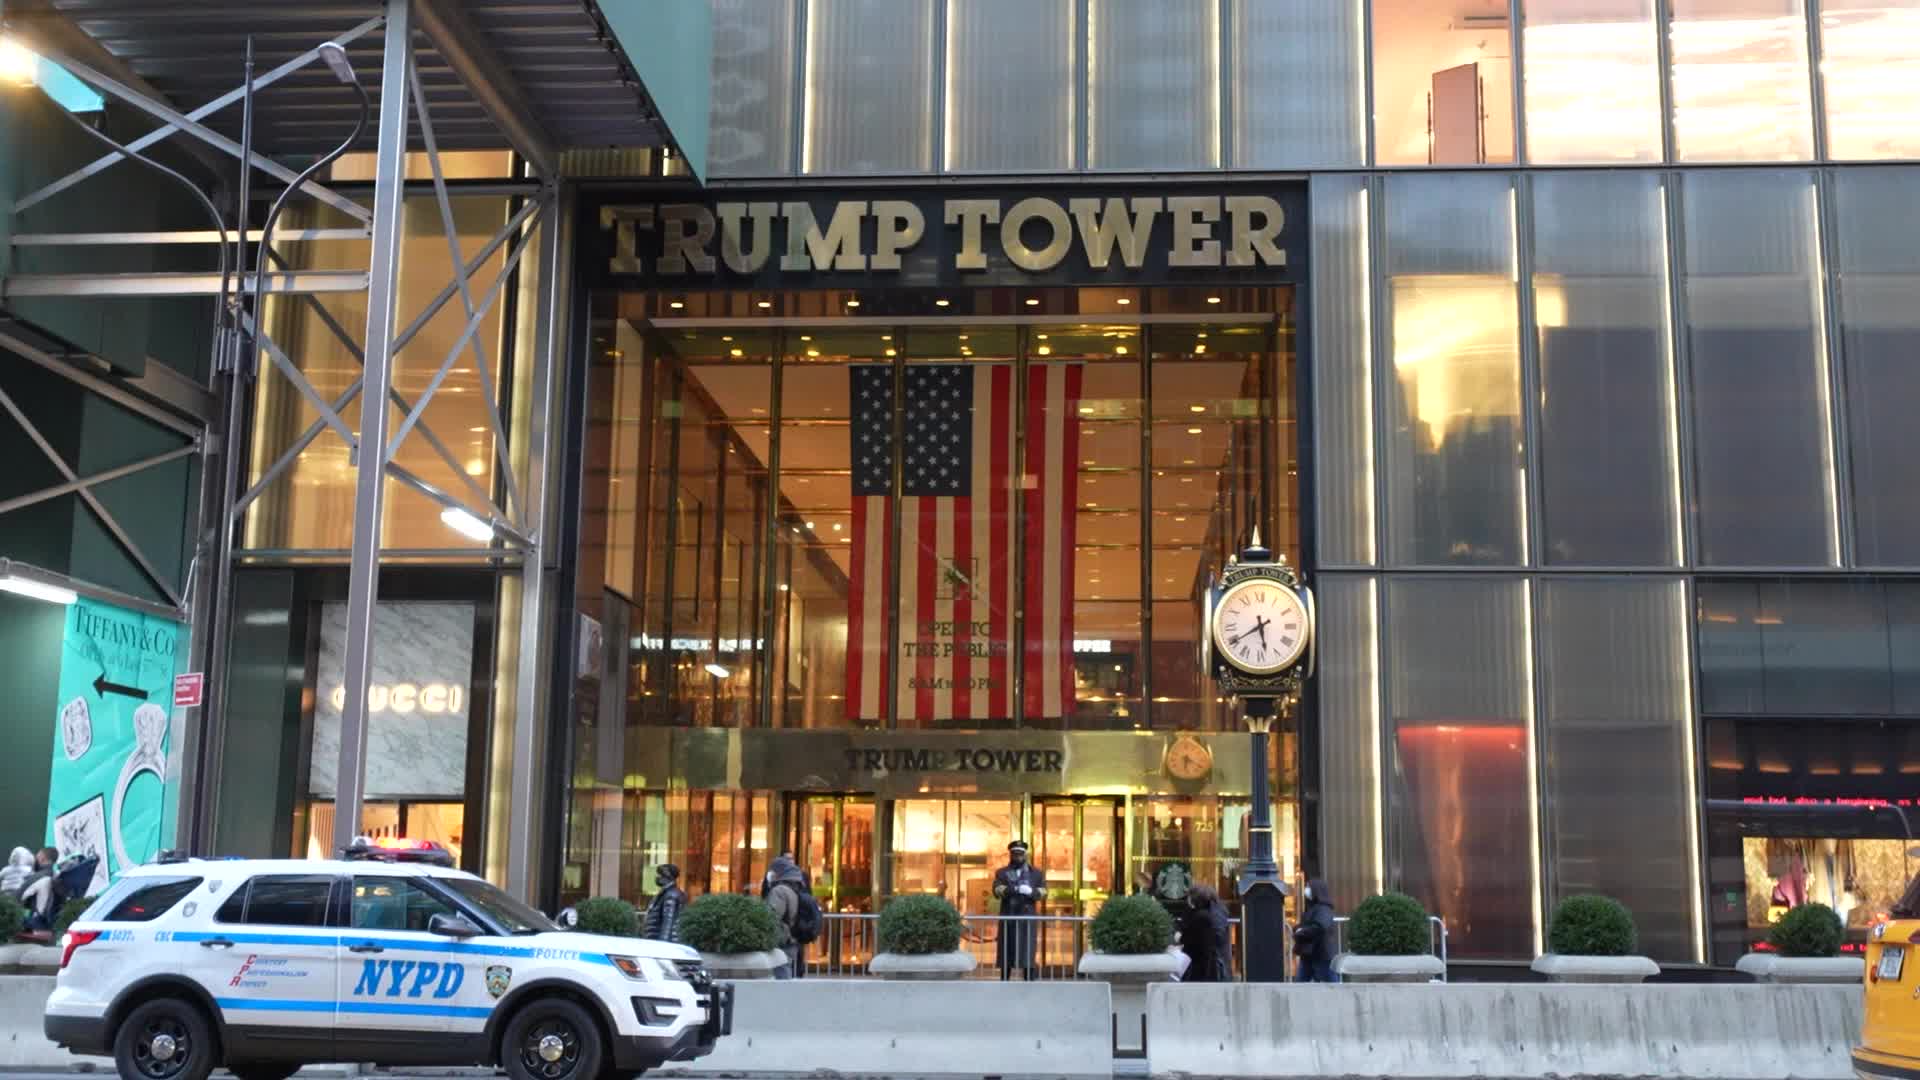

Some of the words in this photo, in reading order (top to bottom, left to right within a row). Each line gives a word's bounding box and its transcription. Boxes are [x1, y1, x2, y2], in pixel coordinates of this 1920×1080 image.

[599, 200, 926, 274] TRUMP
[944, 196, 1287, 270] TOWER
[1229, 569, 1257, 583] TRUMP
[1261, 568, 1292, 583] TOWER
[903, 642, 939, 658] THE
[844, 749, 945, 771] TRUMP
[957, 749, 1063, 771] TOWER
[1195, 821, 1214, 832] 725
[535, 947, 579, 960] POLICE
[353, 959, 465, 999] NYPD
